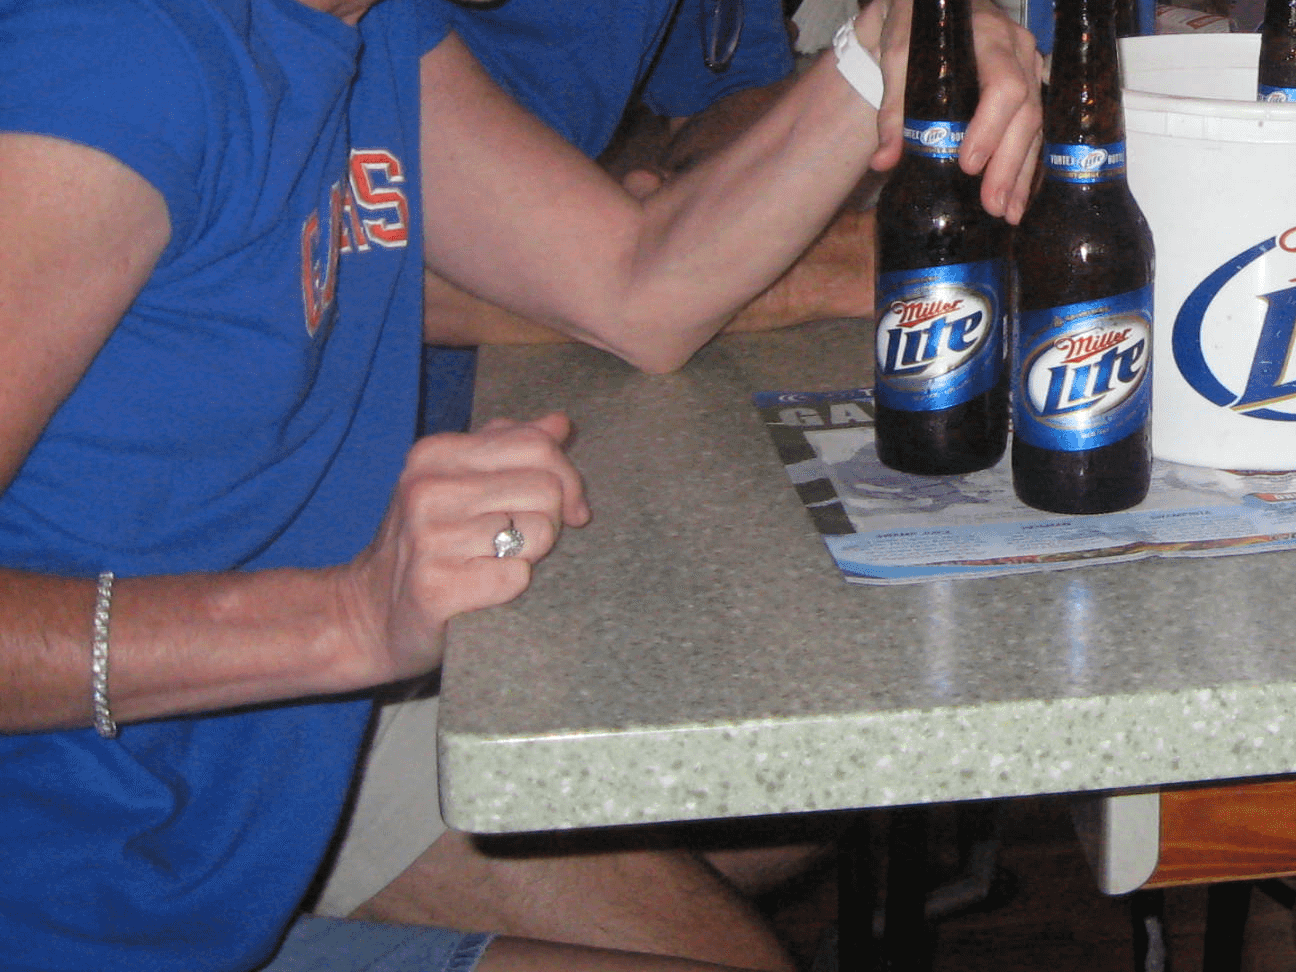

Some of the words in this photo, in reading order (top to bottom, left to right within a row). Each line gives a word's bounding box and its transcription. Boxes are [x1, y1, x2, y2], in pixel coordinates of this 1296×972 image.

[890, 298, 965, 327] Miller
[881, 310, 983, 376] Lite
[1054, 327, 1133, 364] Miller
[1037, 338, 1146, 417] Lite
